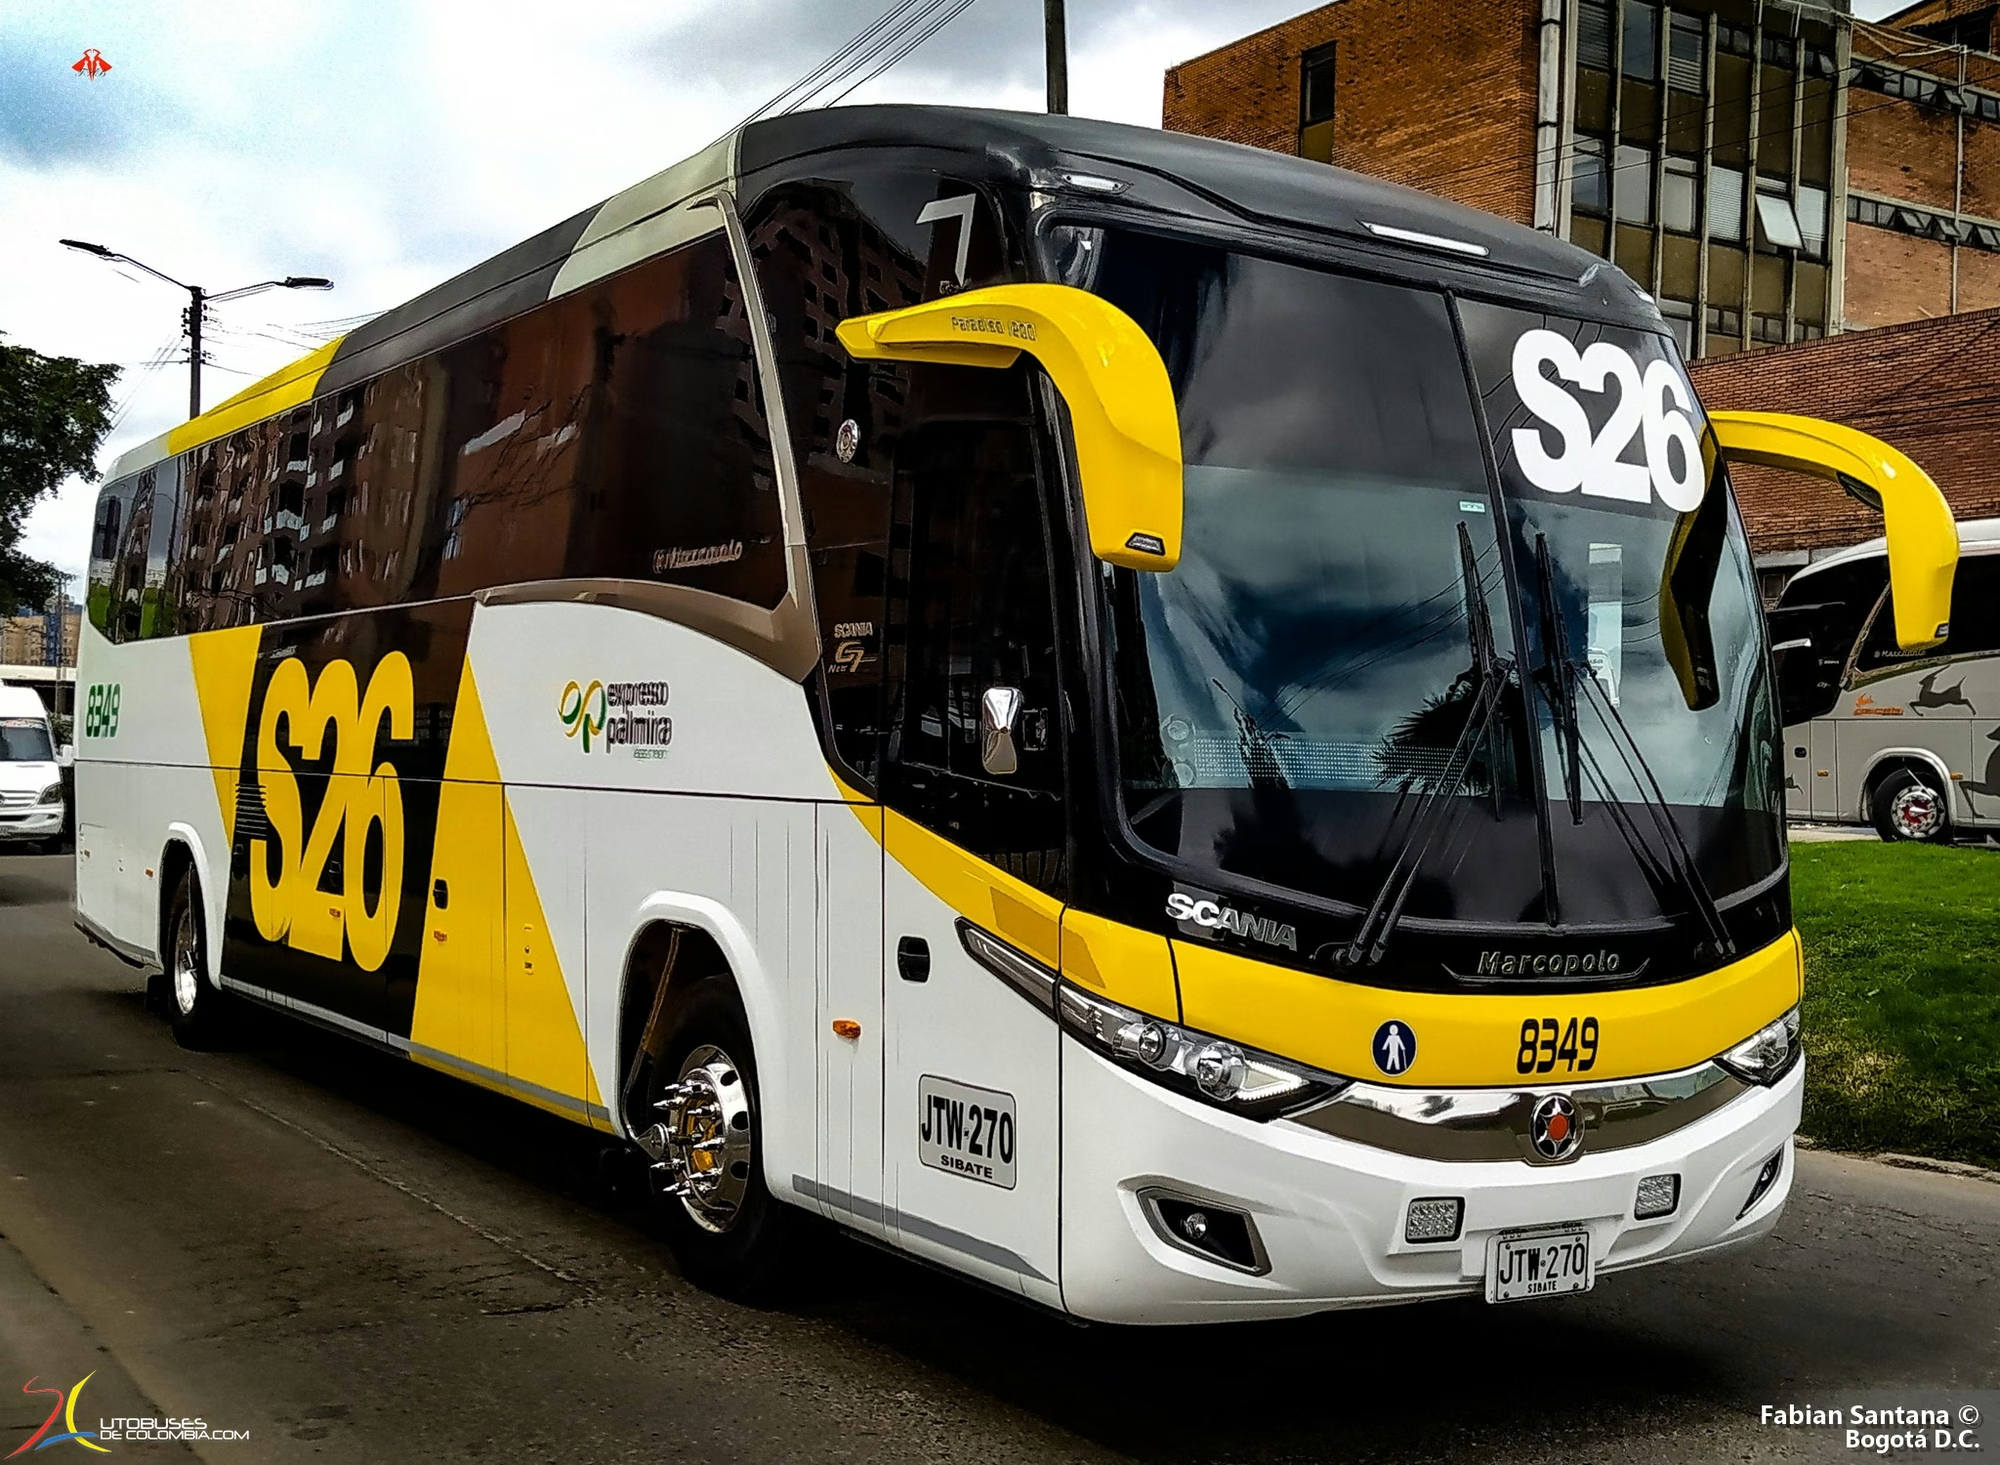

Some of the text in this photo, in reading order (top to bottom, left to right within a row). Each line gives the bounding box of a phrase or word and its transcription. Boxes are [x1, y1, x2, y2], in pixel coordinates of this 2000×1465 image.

[916, 193, 976, 288] 7
[951, 316, 1004, 334] Paradiso
[1511, 329, 1705, 512] S26
[834, 621, 873, 638] SCANIA
[86, 683, 121, 738] 8349
[606, 682, 669, 714] expresso
[606, 710, 672, 754] palmira
[250, 651, 414, 972] S26
[1165, 893, 1298, 951] SCANIA
[1477, 950, 1620, 976] Marcopolo
[1516, 1016, 1599, 1074] 8349
[941, 1155, 993, 1179] SIBATE
[1527, 1281, 1557, 1293] SIBATE
